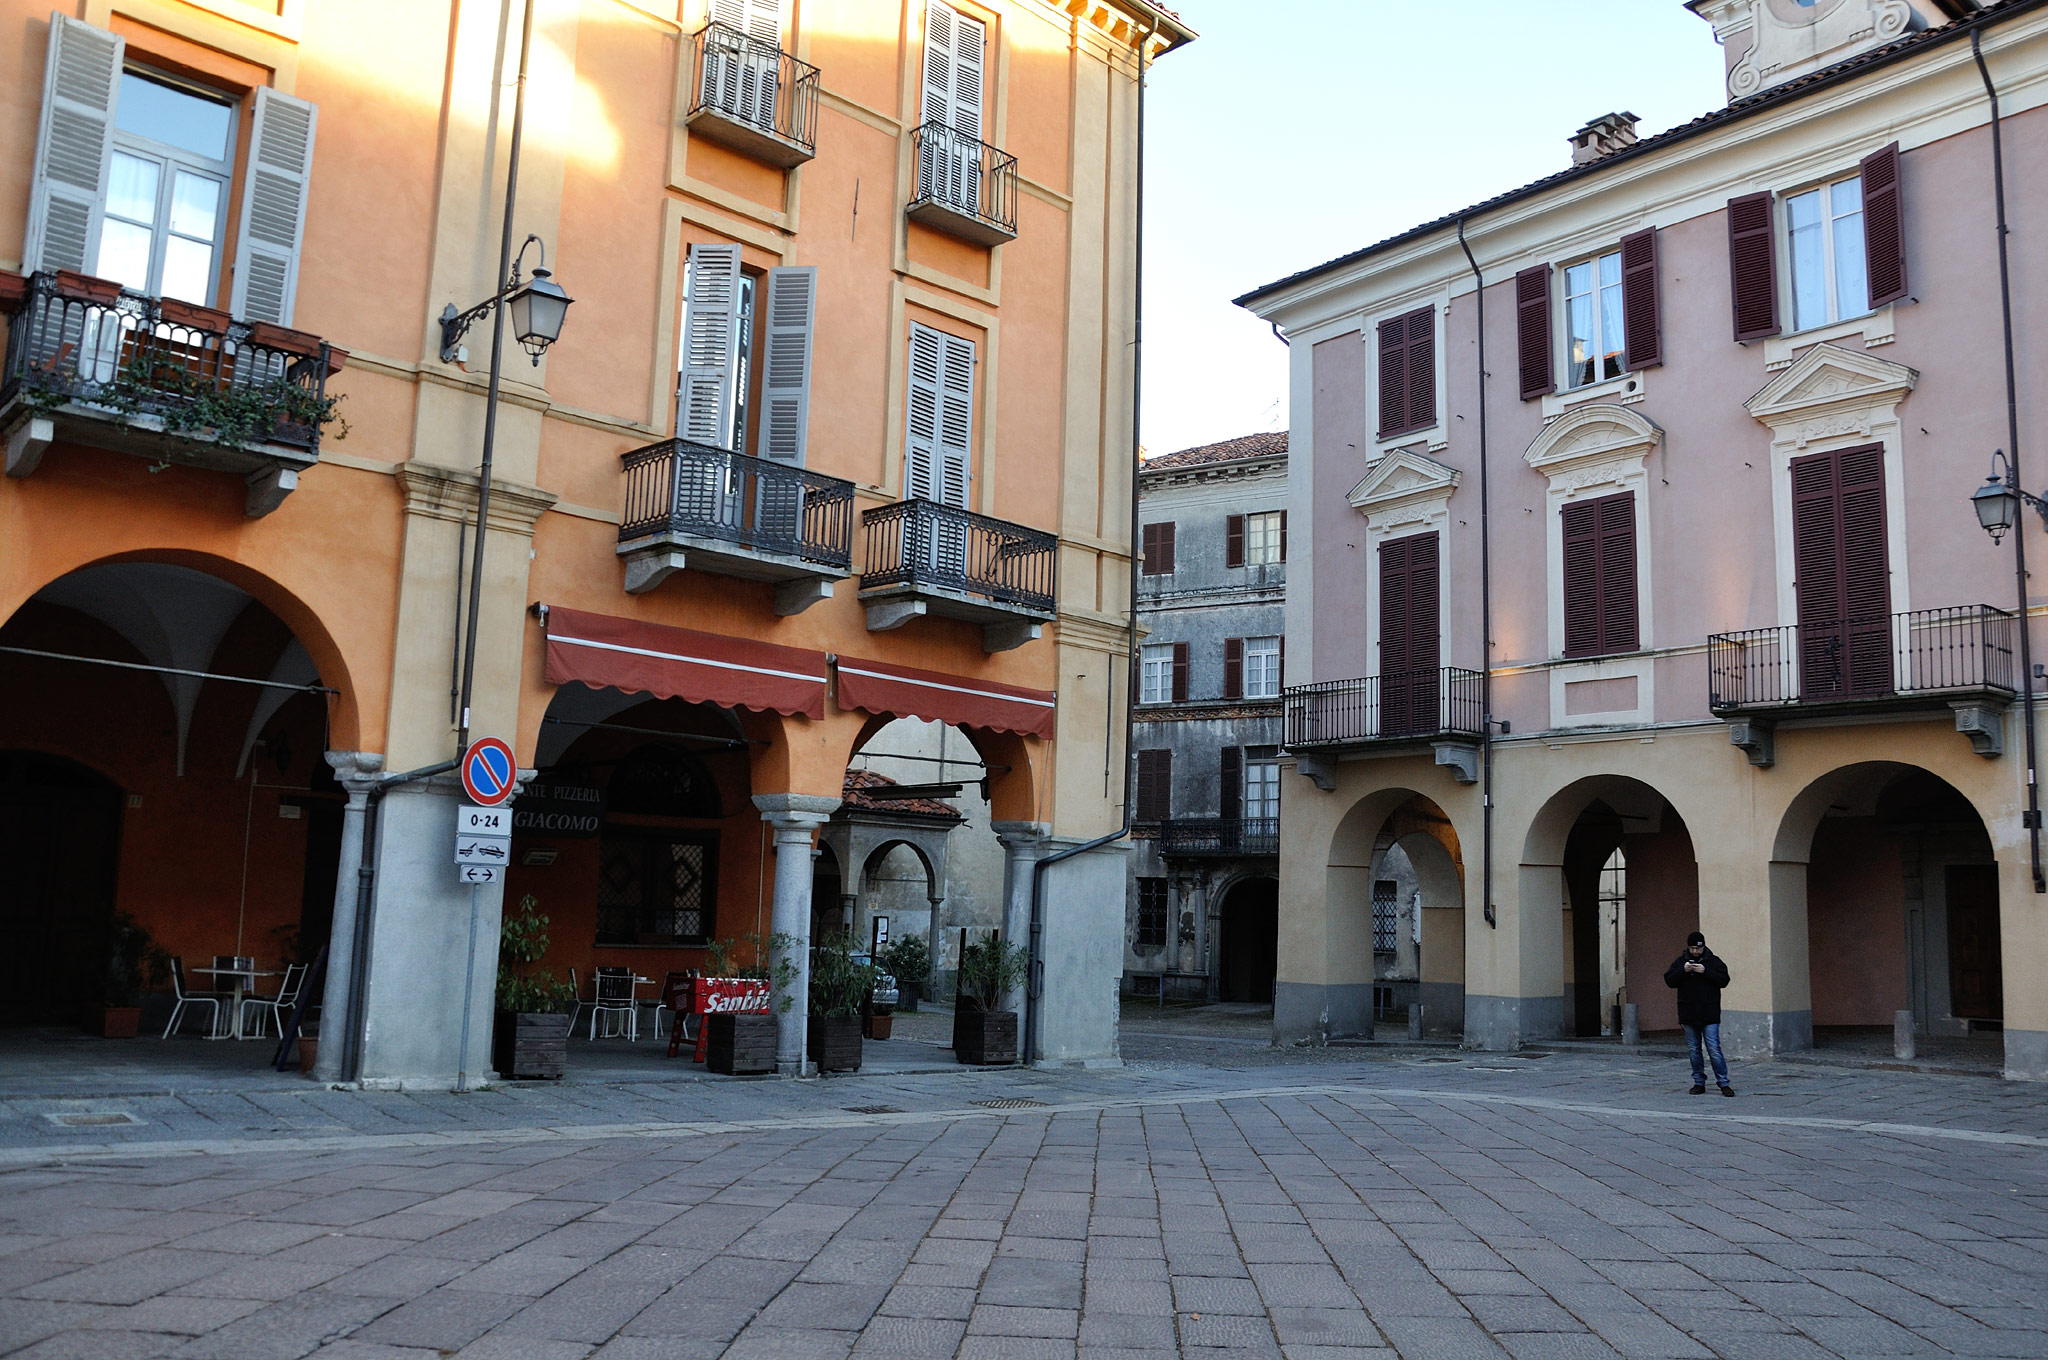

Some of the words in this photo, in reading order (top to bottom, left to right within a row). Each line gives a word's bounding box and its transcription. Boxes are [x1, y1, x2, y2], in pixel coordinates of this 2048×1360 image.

[522, 784, 546, 798] NTE
[554, 786, 600, 802] PIZZERIA
[471, 814, 499, 828] 0-24
[515, 811, 598, 832] GIACOMO
[704, 989, 771, 1013] Sanbit
